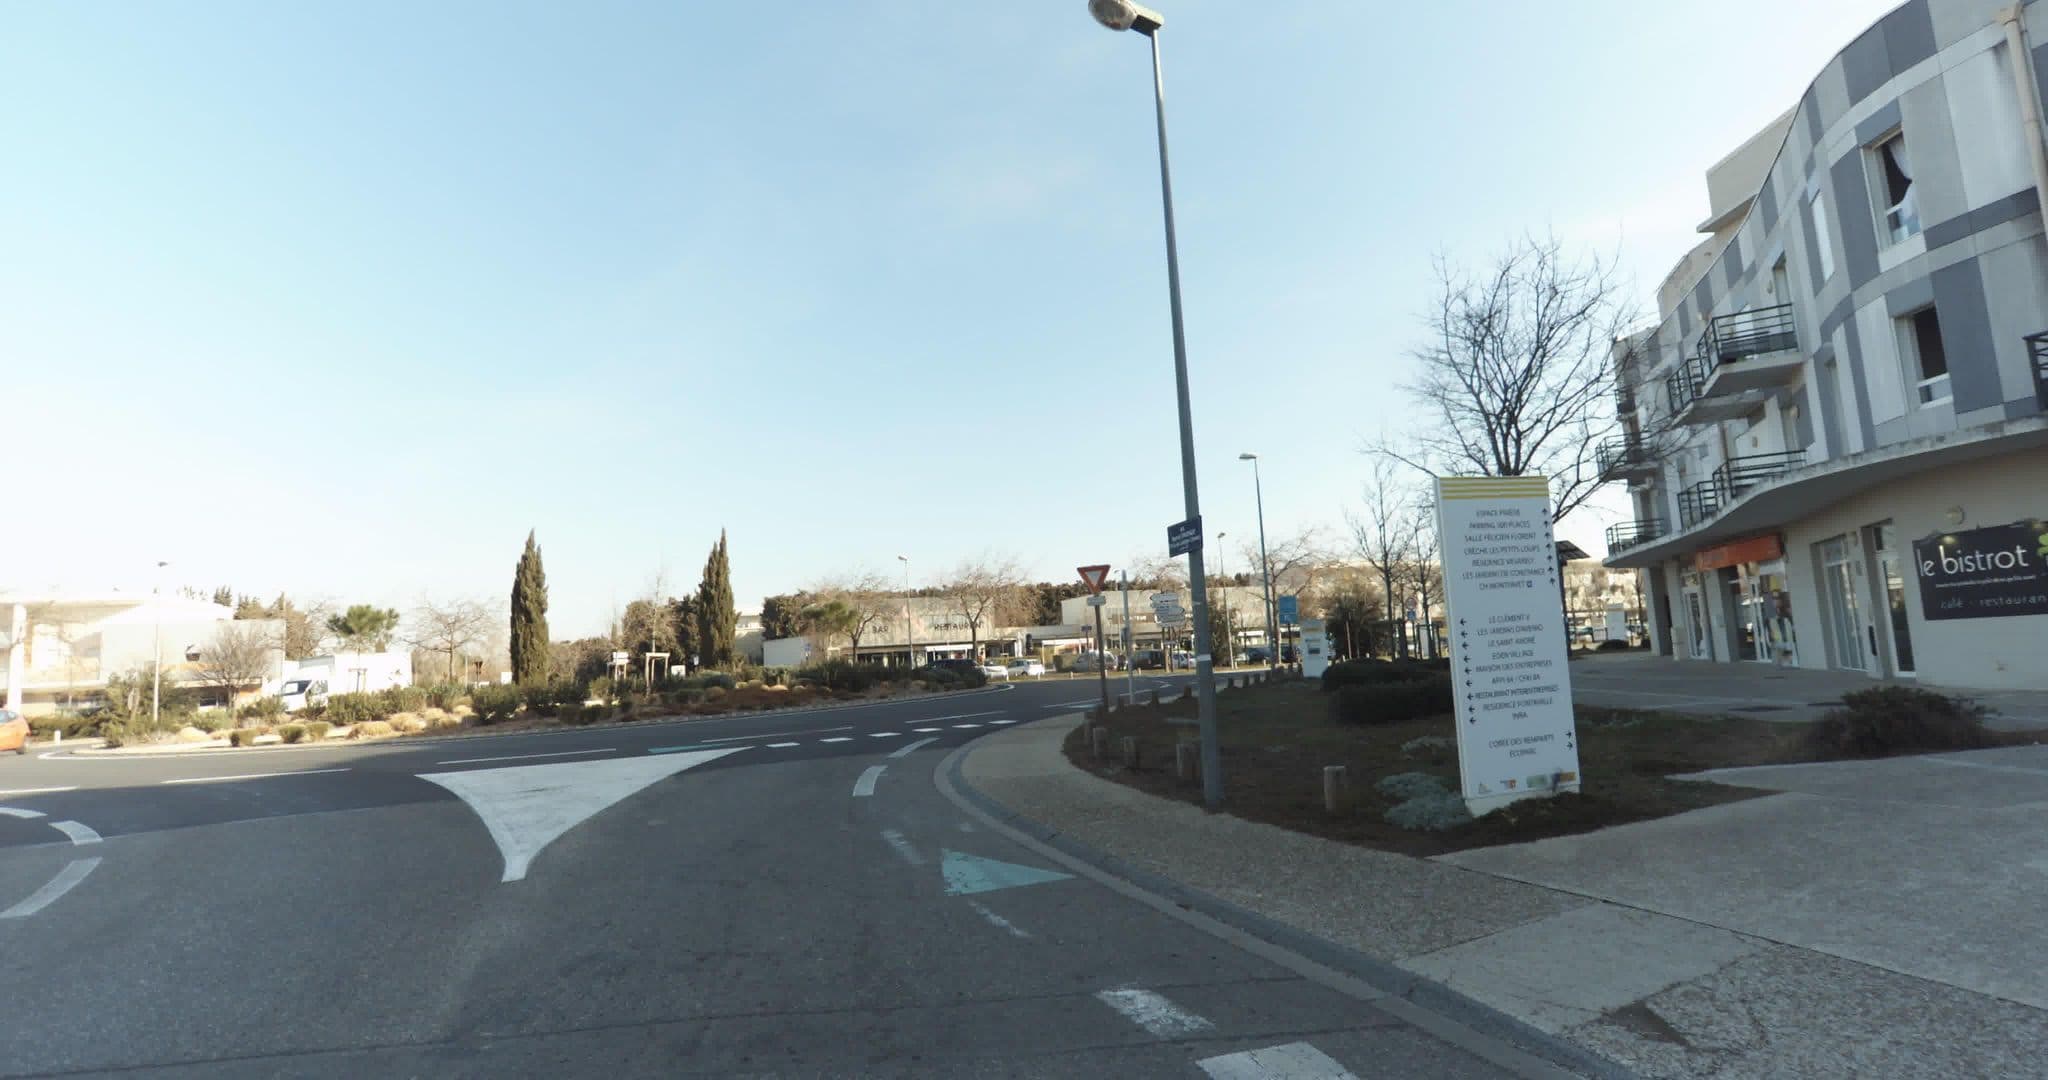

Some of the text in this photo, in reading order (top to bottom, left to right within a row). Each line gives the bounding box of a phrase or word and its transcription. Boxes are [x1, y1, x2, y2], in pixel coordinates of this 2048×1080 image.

[1917, 544, 2030, 577] le bistrot
[934, 620, 984, 631] RESTAURNT
